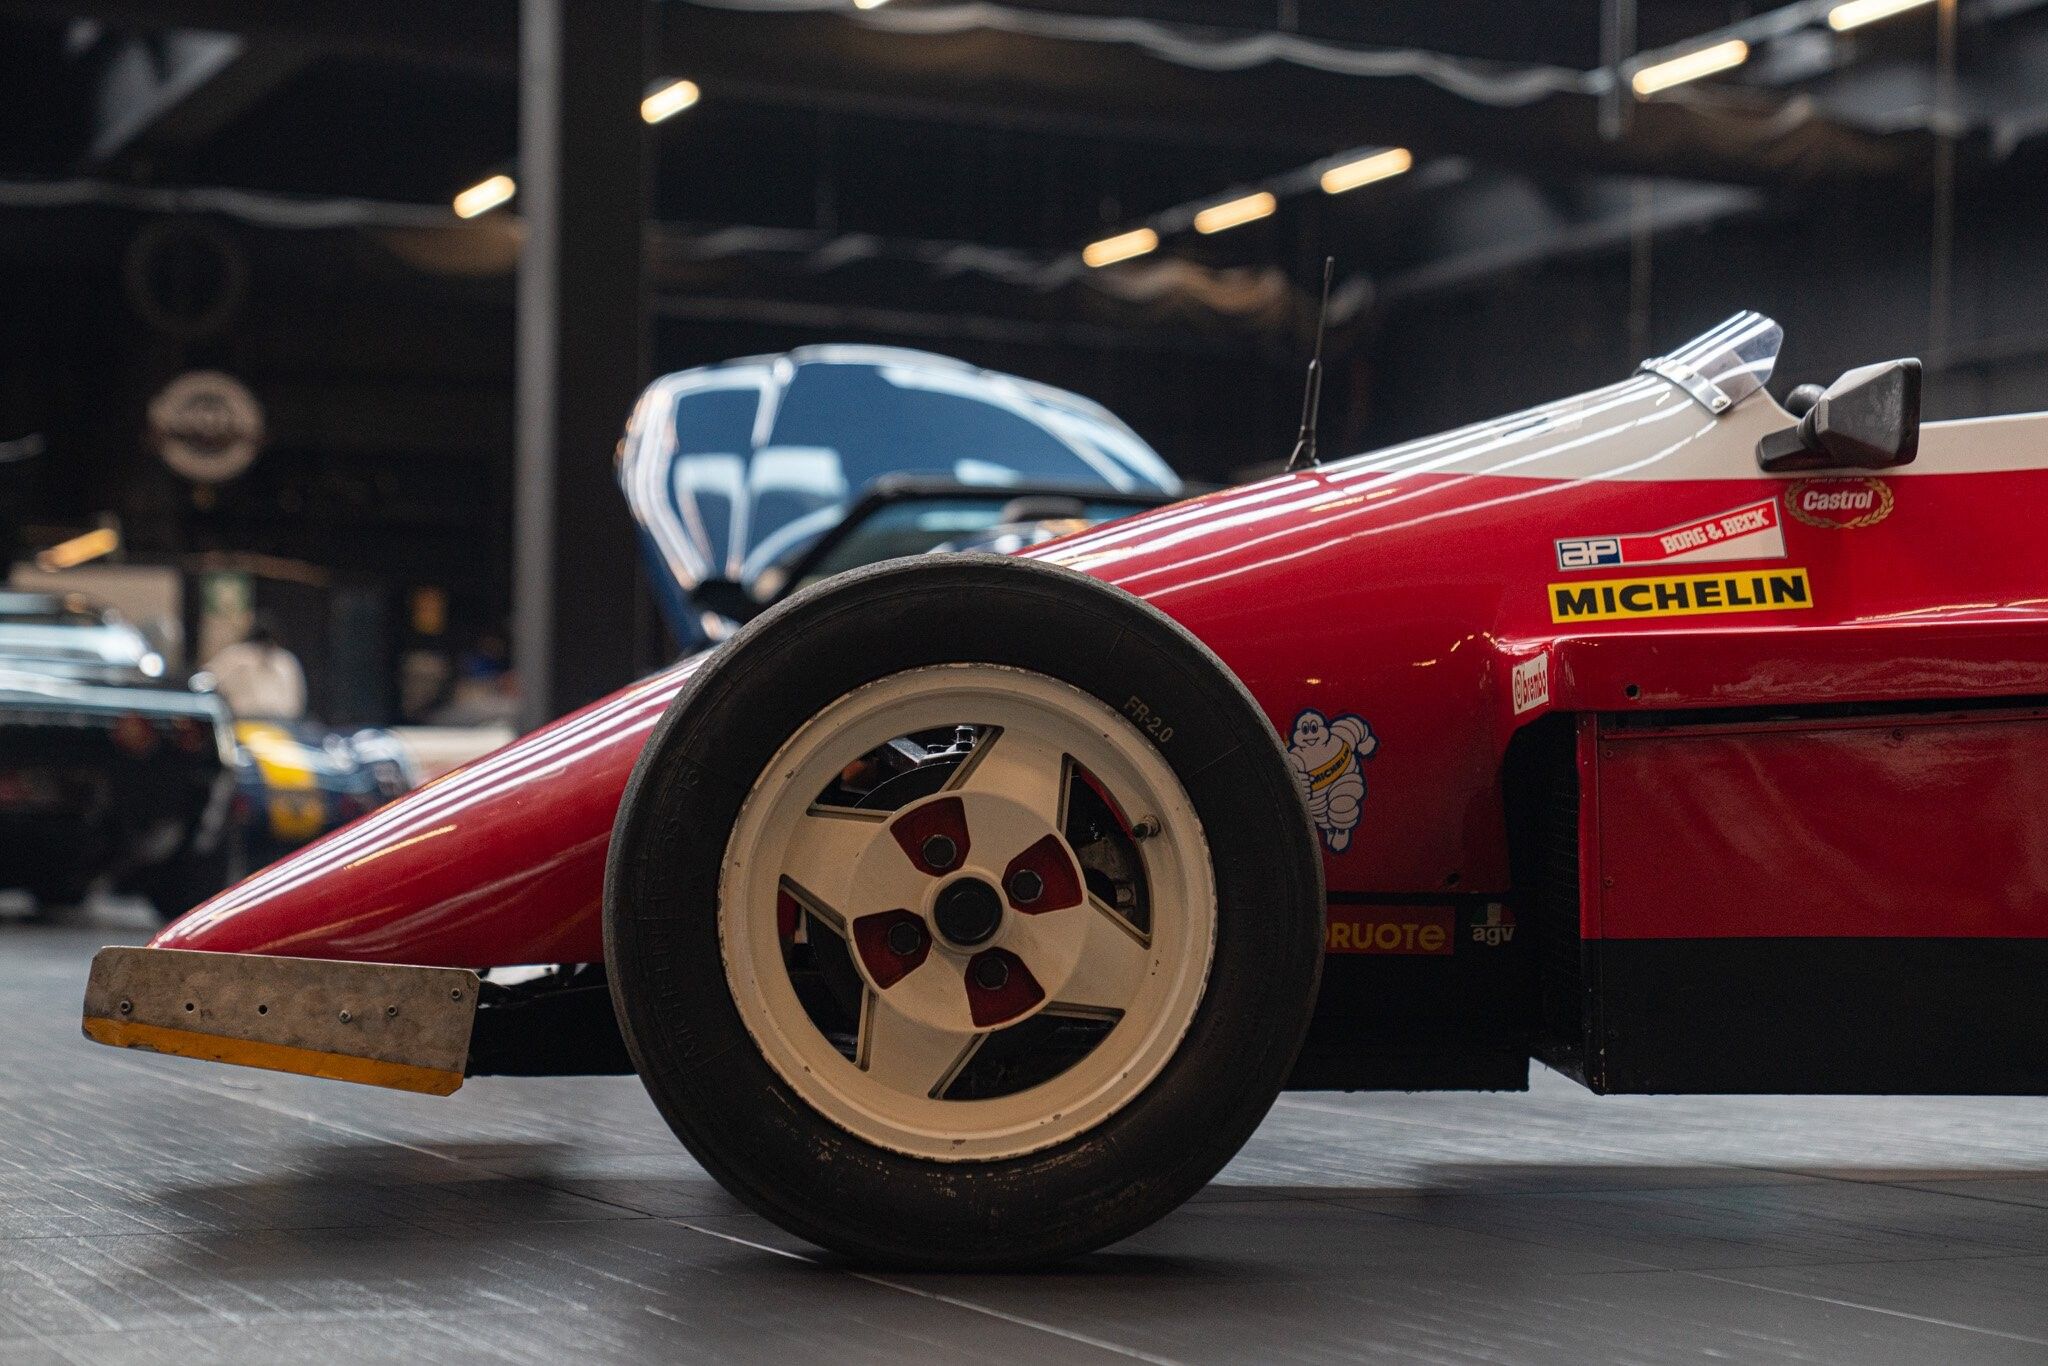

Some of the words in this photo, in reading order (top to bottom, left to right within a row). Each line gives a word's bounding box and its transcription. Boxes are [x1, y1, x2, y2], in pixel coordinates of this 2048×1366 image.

[1803, 489, 1874, 511] Castrol
[1660, 523, 1707, 555] BORG
[1707, 520, 1724, 541] &
[1721, 508, 1769, 536] BECK
[1555, 575, 1808, 617] MICHELIN
[1522, 662, 1547, 705] brembo
[1123, 695, 1174, 743] FR-2.0
[1472, 926, 1516, 946] agv
